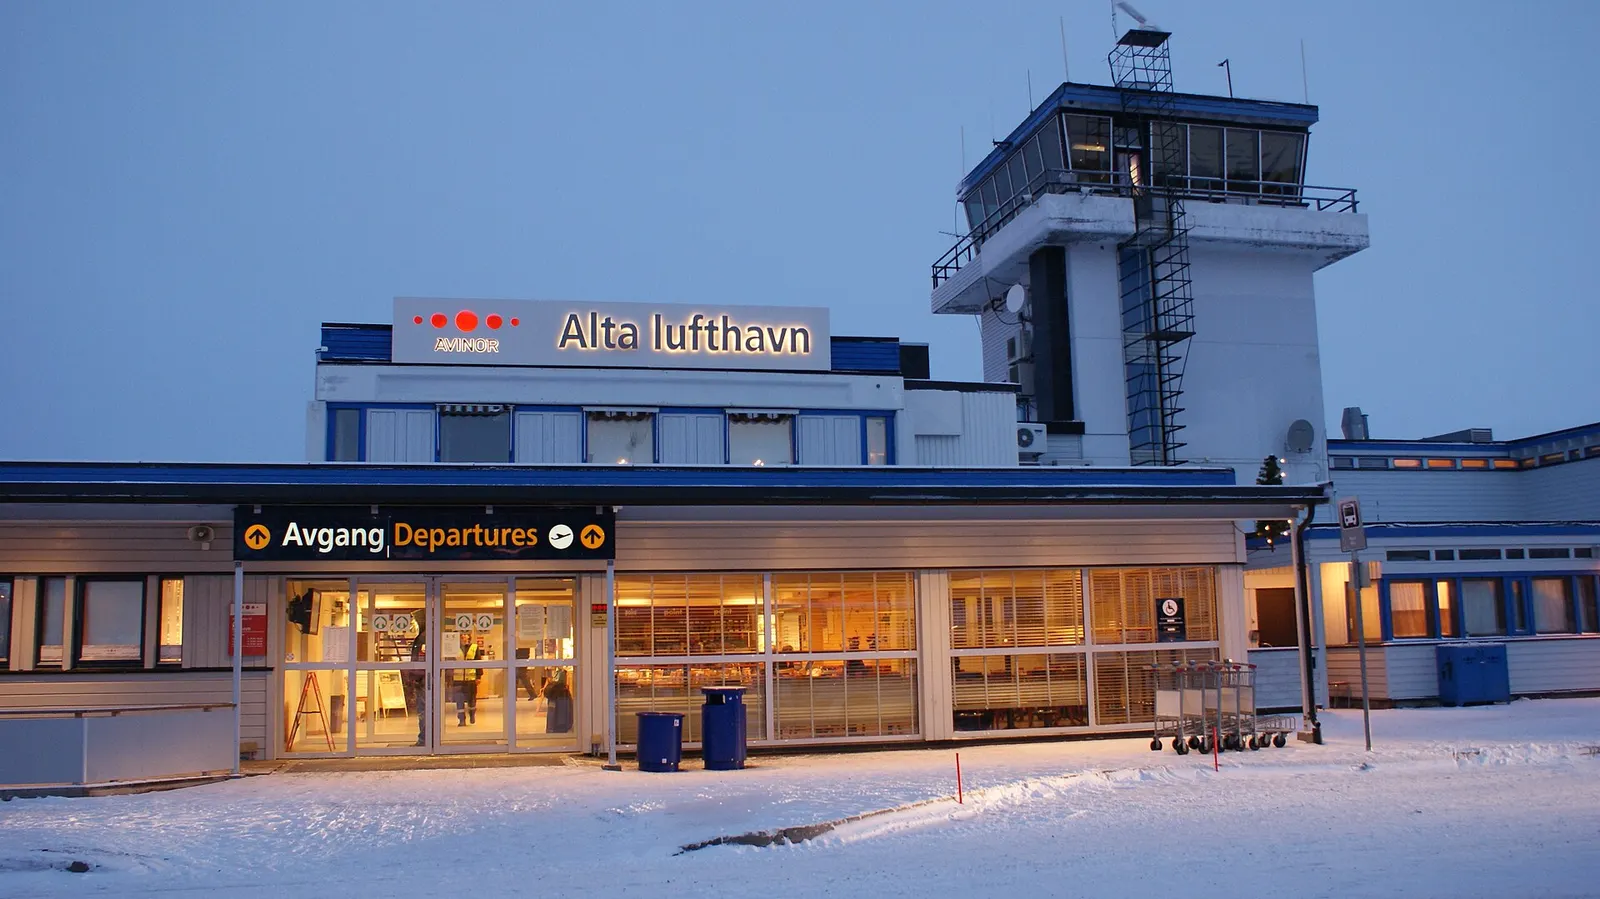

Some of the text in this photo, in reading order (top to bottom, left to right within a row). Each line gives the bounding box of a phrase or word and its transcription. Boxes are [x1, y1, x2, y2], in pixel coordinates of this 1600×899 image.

[434, 337, 500, 353] AVINOR
[558, 311, 810, 353] Alta lufthavn
[281, 521, 538, 553] Avgang Departures
